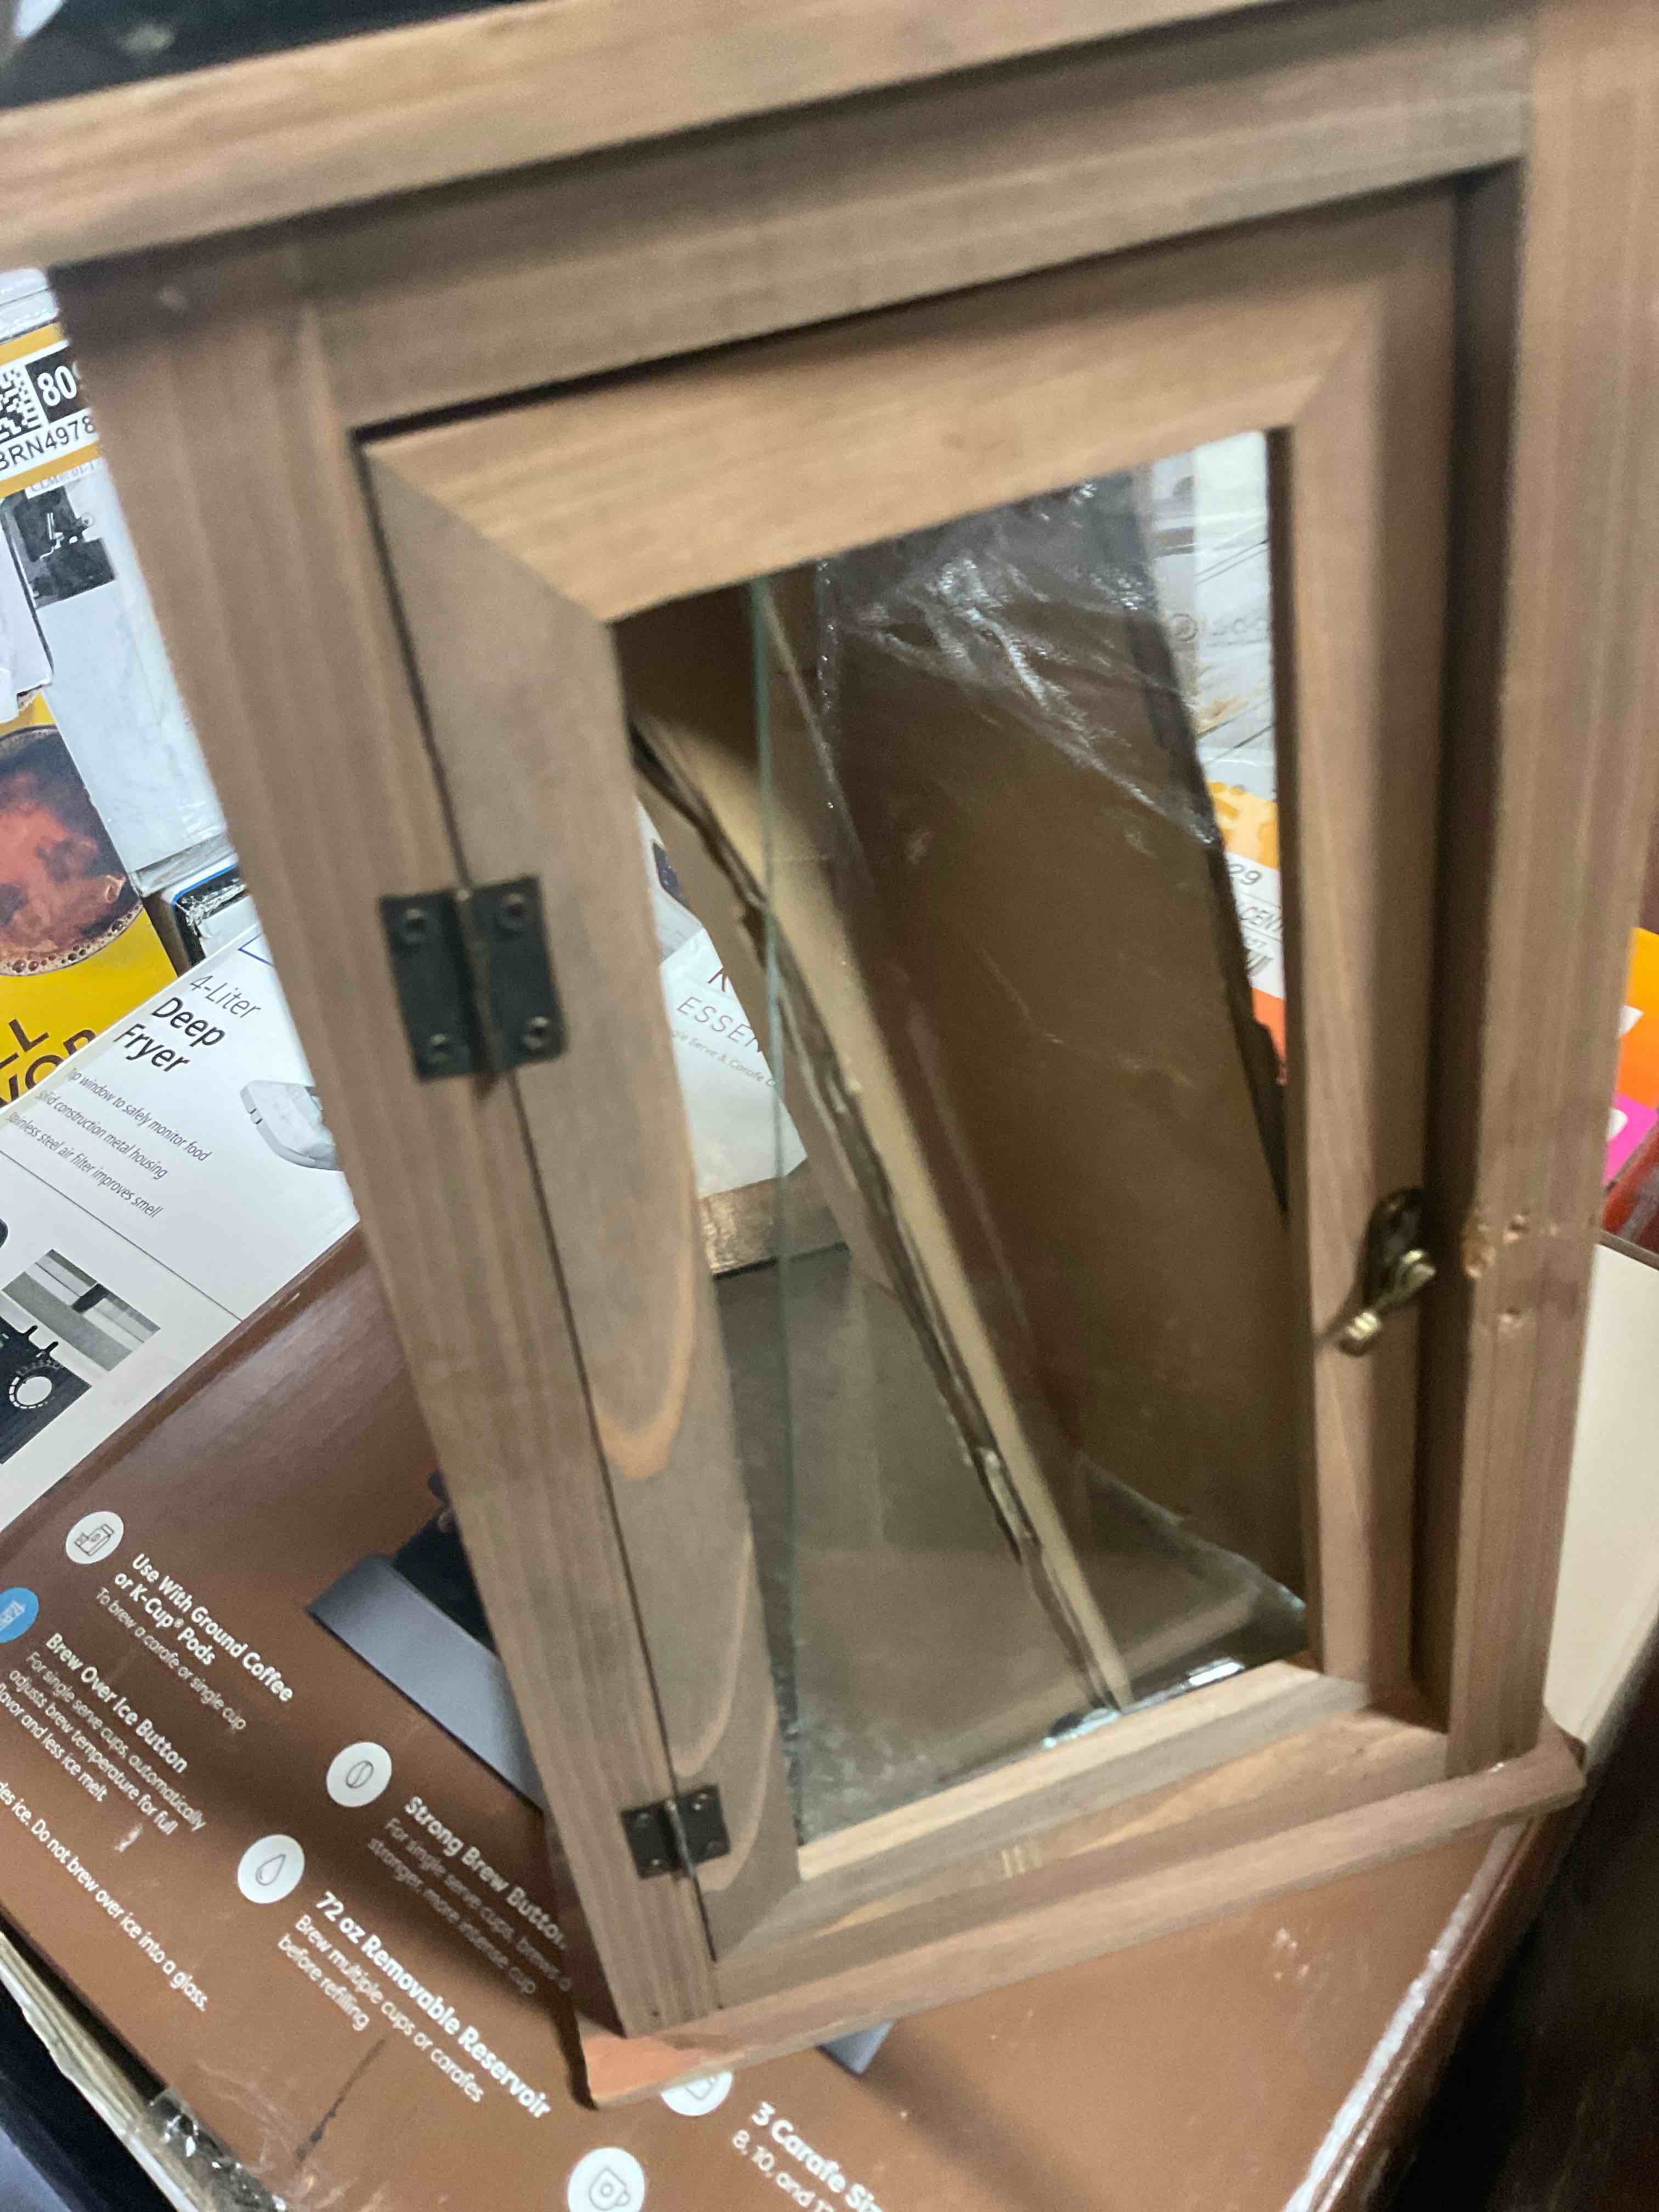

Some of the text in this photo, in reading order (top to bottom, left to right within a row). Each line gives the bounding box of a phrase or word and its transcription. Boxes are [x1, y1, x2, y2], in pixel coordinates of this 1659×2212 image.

[150, 997, 225, 1047] Deep
[190, 975, 261, 1018] 4-Liter
[113, 1023, 190, 1072] Fryer
[54, 1102, 106, 1138] construction
[103, 1133, 136, 1155] metal
[129, 1148, 169, 1180] housing
[80, 1077, 116, 1101] window
[112, 1097, 126, 1108] to
[122, 1105, 152, 1126] safely
[149, 1121, 187, 1147] monitor
[184, 1141, 213, 1161] food
[37, 1133, 66, 1151] steel
[58, 1147, 75, 1159] air
[71, 1153, 95, 1173] filter
[92, 1167, 135, 1201] improves
[131, 1197, 164, 1218] smell
[97, 1587, 246, 1730] To brew a carafe or single cup
[115, 1573, 133, 1589] or
[178, 1627, 215, 1665] Pods
[133, 1553, 293, 1702] Use With Ground Coffee
[26, 1651, 47, 1673] For
[43, 1671, 75, 1703] single
[72, 1700, 103, 1730] serve
[128, 1755, 207, 1832] automatically
[46, 1633, 188, 1773] Brew Over Ice Button
[9, 1670, 179, 1835] adjusts brew temperature for full
[21, 1715, 48, 1739] and
[42, 1733, 65, 1759] less
[61, 1753, 81, 1776] ice
[78, 1771, 108, 1803] melt
[12, 1797, 32, 1826] ice.
[31, 1818, 50, 1842] Do
[47, 1838, 71, 1864] not
[66, 1856, 99, 1892] brew
[95, 1889, 125, 1918] over
[120, 1912, 142, 1939] ice
[139, 1931, 165, 1963] into
[162, 1960, 176, 1975] a
[386, 1817, 409, 1841] For
[405, 1838, 447, 1878] single
[404, 1796, 465, 1857] Strong
[461, 1847, 509, 1892] Brew
[278, 1932, 370, 2032] before refilling
[295, 1914, 484, 2103] Brew multiple cups or carafes
[315, 1891, 551, 2118] 72 oz Removable Reservoir
[508, 1966, 536, 1994] cup
[751, 2101, 776, 2126] 3
[771, 2119, 846, 2193] Carafe
[776, 2172, 816, 2207] and
